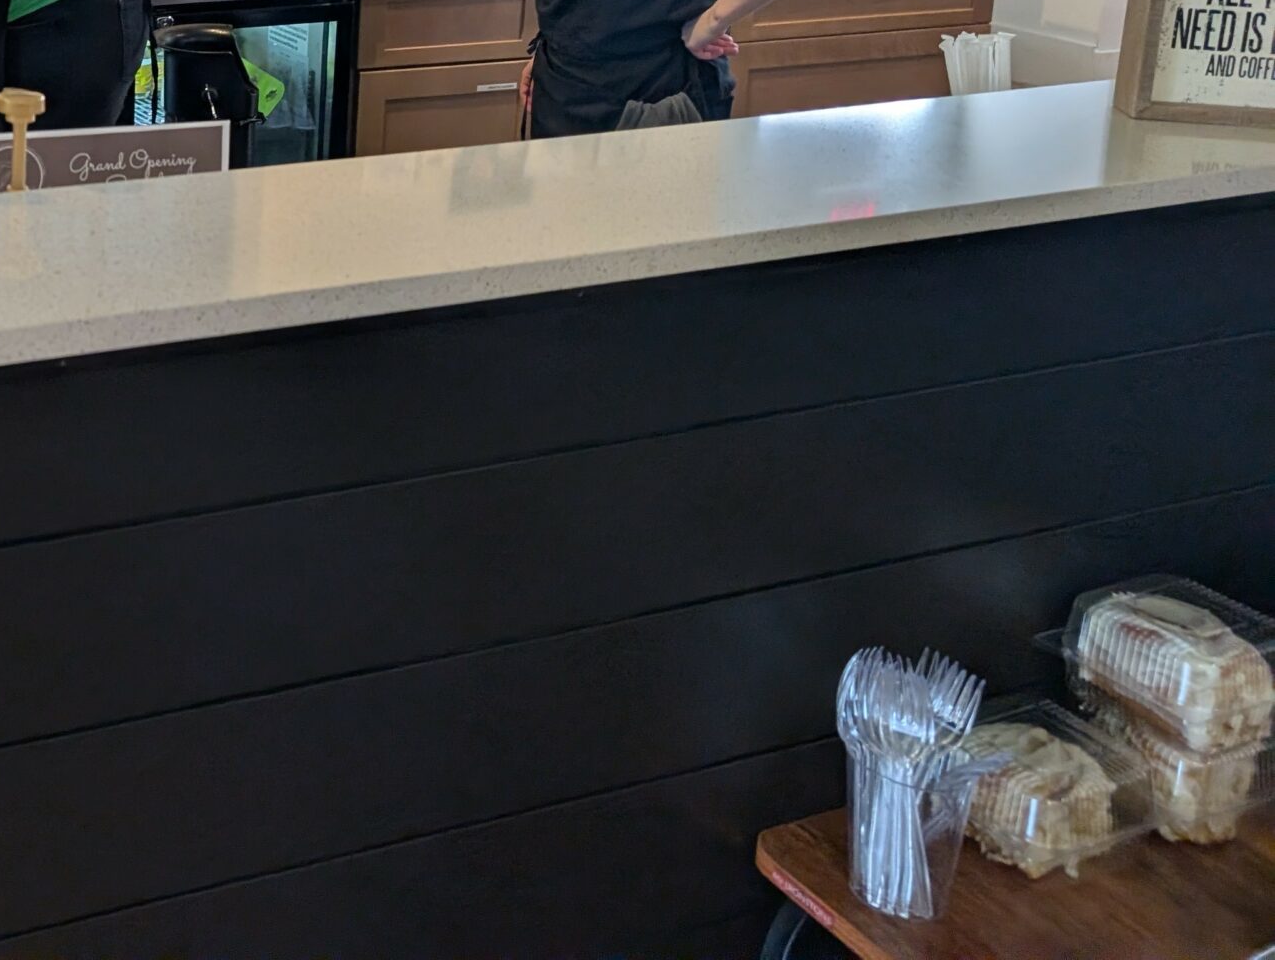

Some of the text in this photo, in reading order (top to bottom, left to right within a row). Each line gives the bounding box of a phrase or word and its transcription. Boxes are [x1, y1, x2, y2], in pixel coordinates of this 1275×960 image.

[1171, 7, 1266, 53] NEED IS
[1205, 54, 1235, 77] AND
[70, 149, 197, 181] Grand Opening
